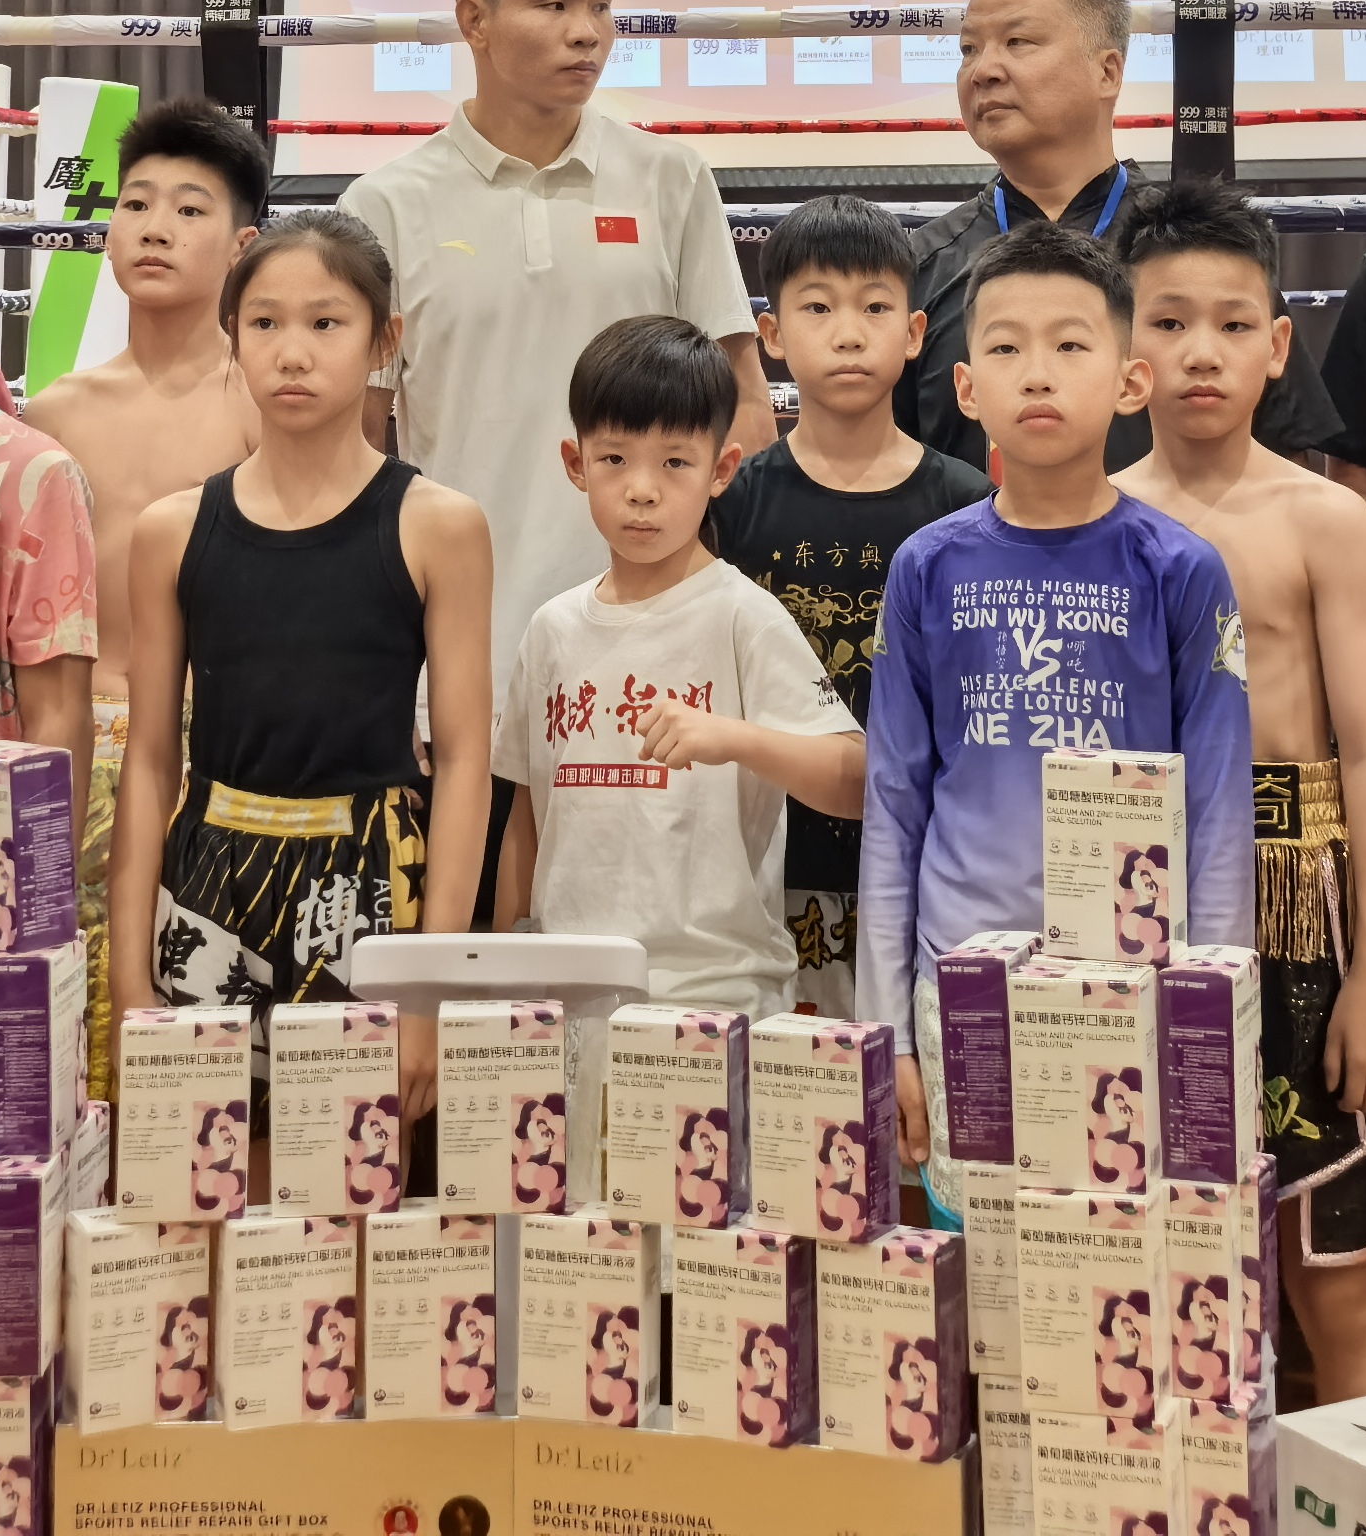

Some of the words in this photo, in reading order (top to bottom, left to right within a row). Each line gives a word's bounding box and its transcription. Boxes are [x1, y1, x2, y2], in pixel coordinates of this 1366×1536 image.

[849, 10, 890, 29] 999
[899, 8, 944, 29] 澳诺
[1269, 1, 1316, 21] 澳诺
[121, 18, 161, 37] 999
[1179, 107, 1200, 119] 999
[1204, 106, 1228, 119] 澳诺
[953, 581, 978, 597] HIS
[984, 580, 1034, 593] ROYAL
[1042, 580, 1131, 601] HIGHNESS
[952, 594, 977, 609] THE
[982, 593, 1021, 606] KING
[1025, 593, 1046, 606] OF
[1051, 595, 1130, 615] MONKEYS
[952, 609, 998, 632] SUN
[1007, 609, 1046, 631] WU
[1056, 610, 1129, 638] KONG
[963, 693, 1015, 711] PRINCE
[1024, 693, 1093, 715] LOTUS
[1102, 701, 1124, 719] III
[963, 712, 1010, 746] NE
[1029, 714, 1111, 751] ZHA
[149, 1500, 266, 1514] PROFESSIONAL
[602, 1505, 714, 1530] PROFESSIONAL
[75, 1517, 135, 1530] SPORTS
[141, 1516, 192, 1528] RELIEF
[199, 1515, 253, 1527] REPAIR
[258, 1515, 292, 1527] GIFT
[299, 1514, 329, 1526] BOX
[533, 1515, 590, 1531] SPORTS
